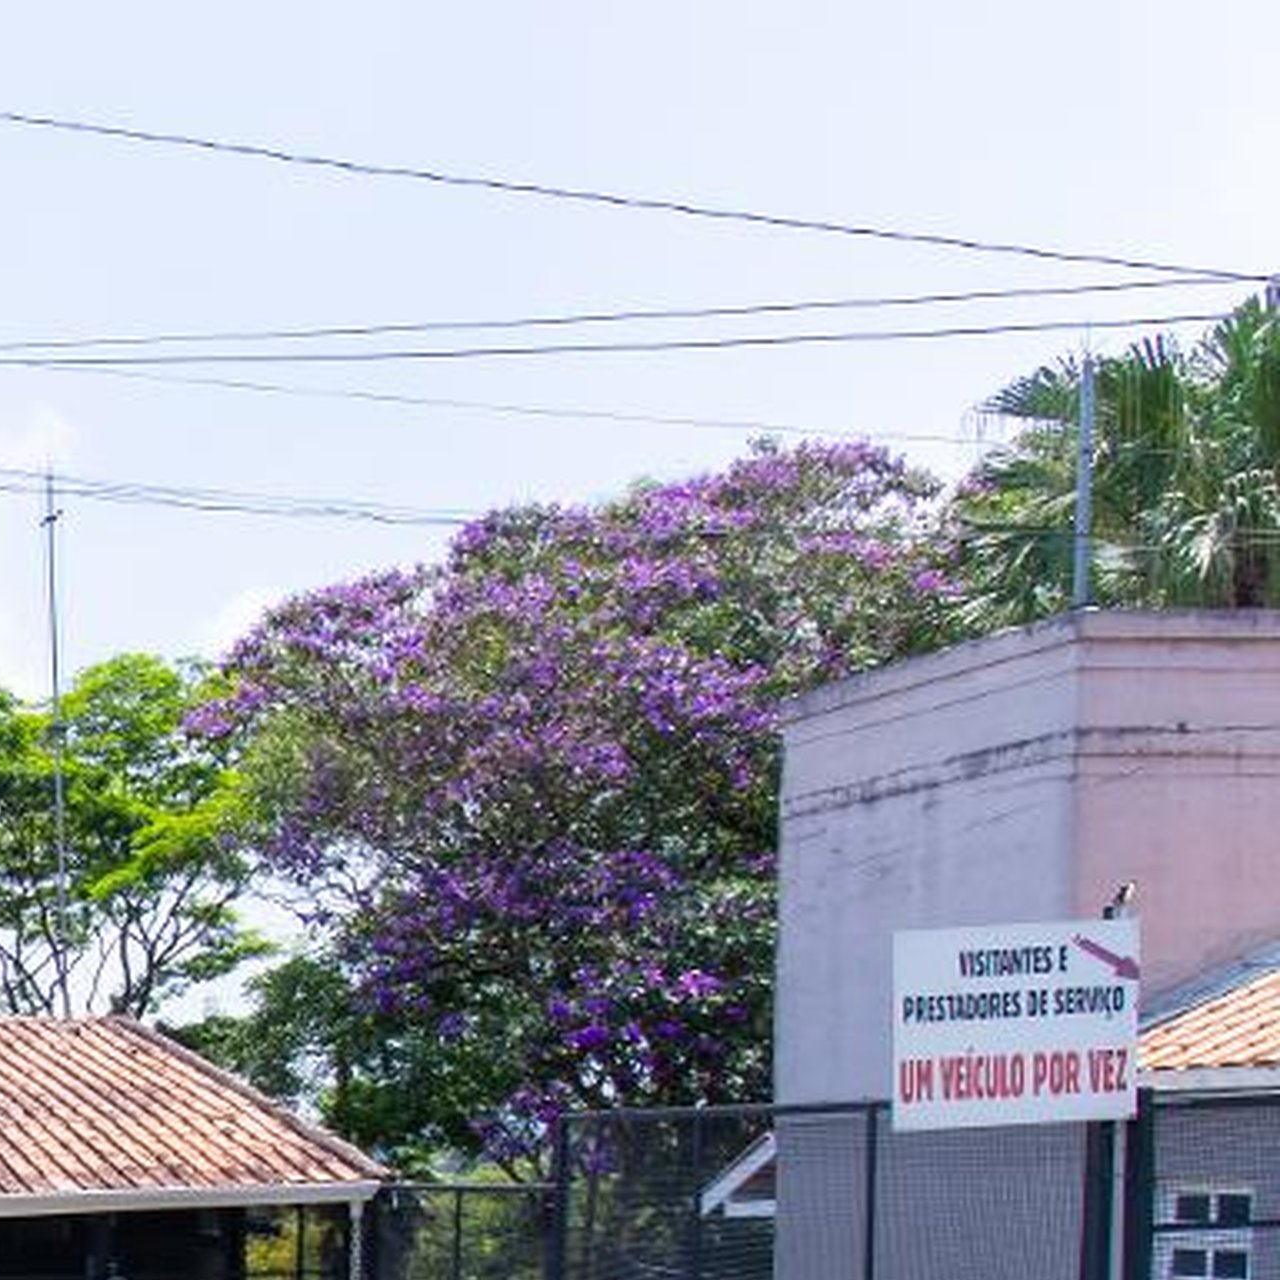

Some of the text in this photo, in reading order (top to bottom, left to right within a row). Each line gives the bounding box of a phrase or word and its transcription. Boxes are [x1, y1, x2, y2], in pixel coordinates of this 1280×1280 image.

[959, 946, 1067, 977] VISITANTES E
[902, 986, 1125, 1023] PRESTADORES DE SERVIÇO
[900, 1047, 1127, 1104] UM VEÍCULO POR VEZ
